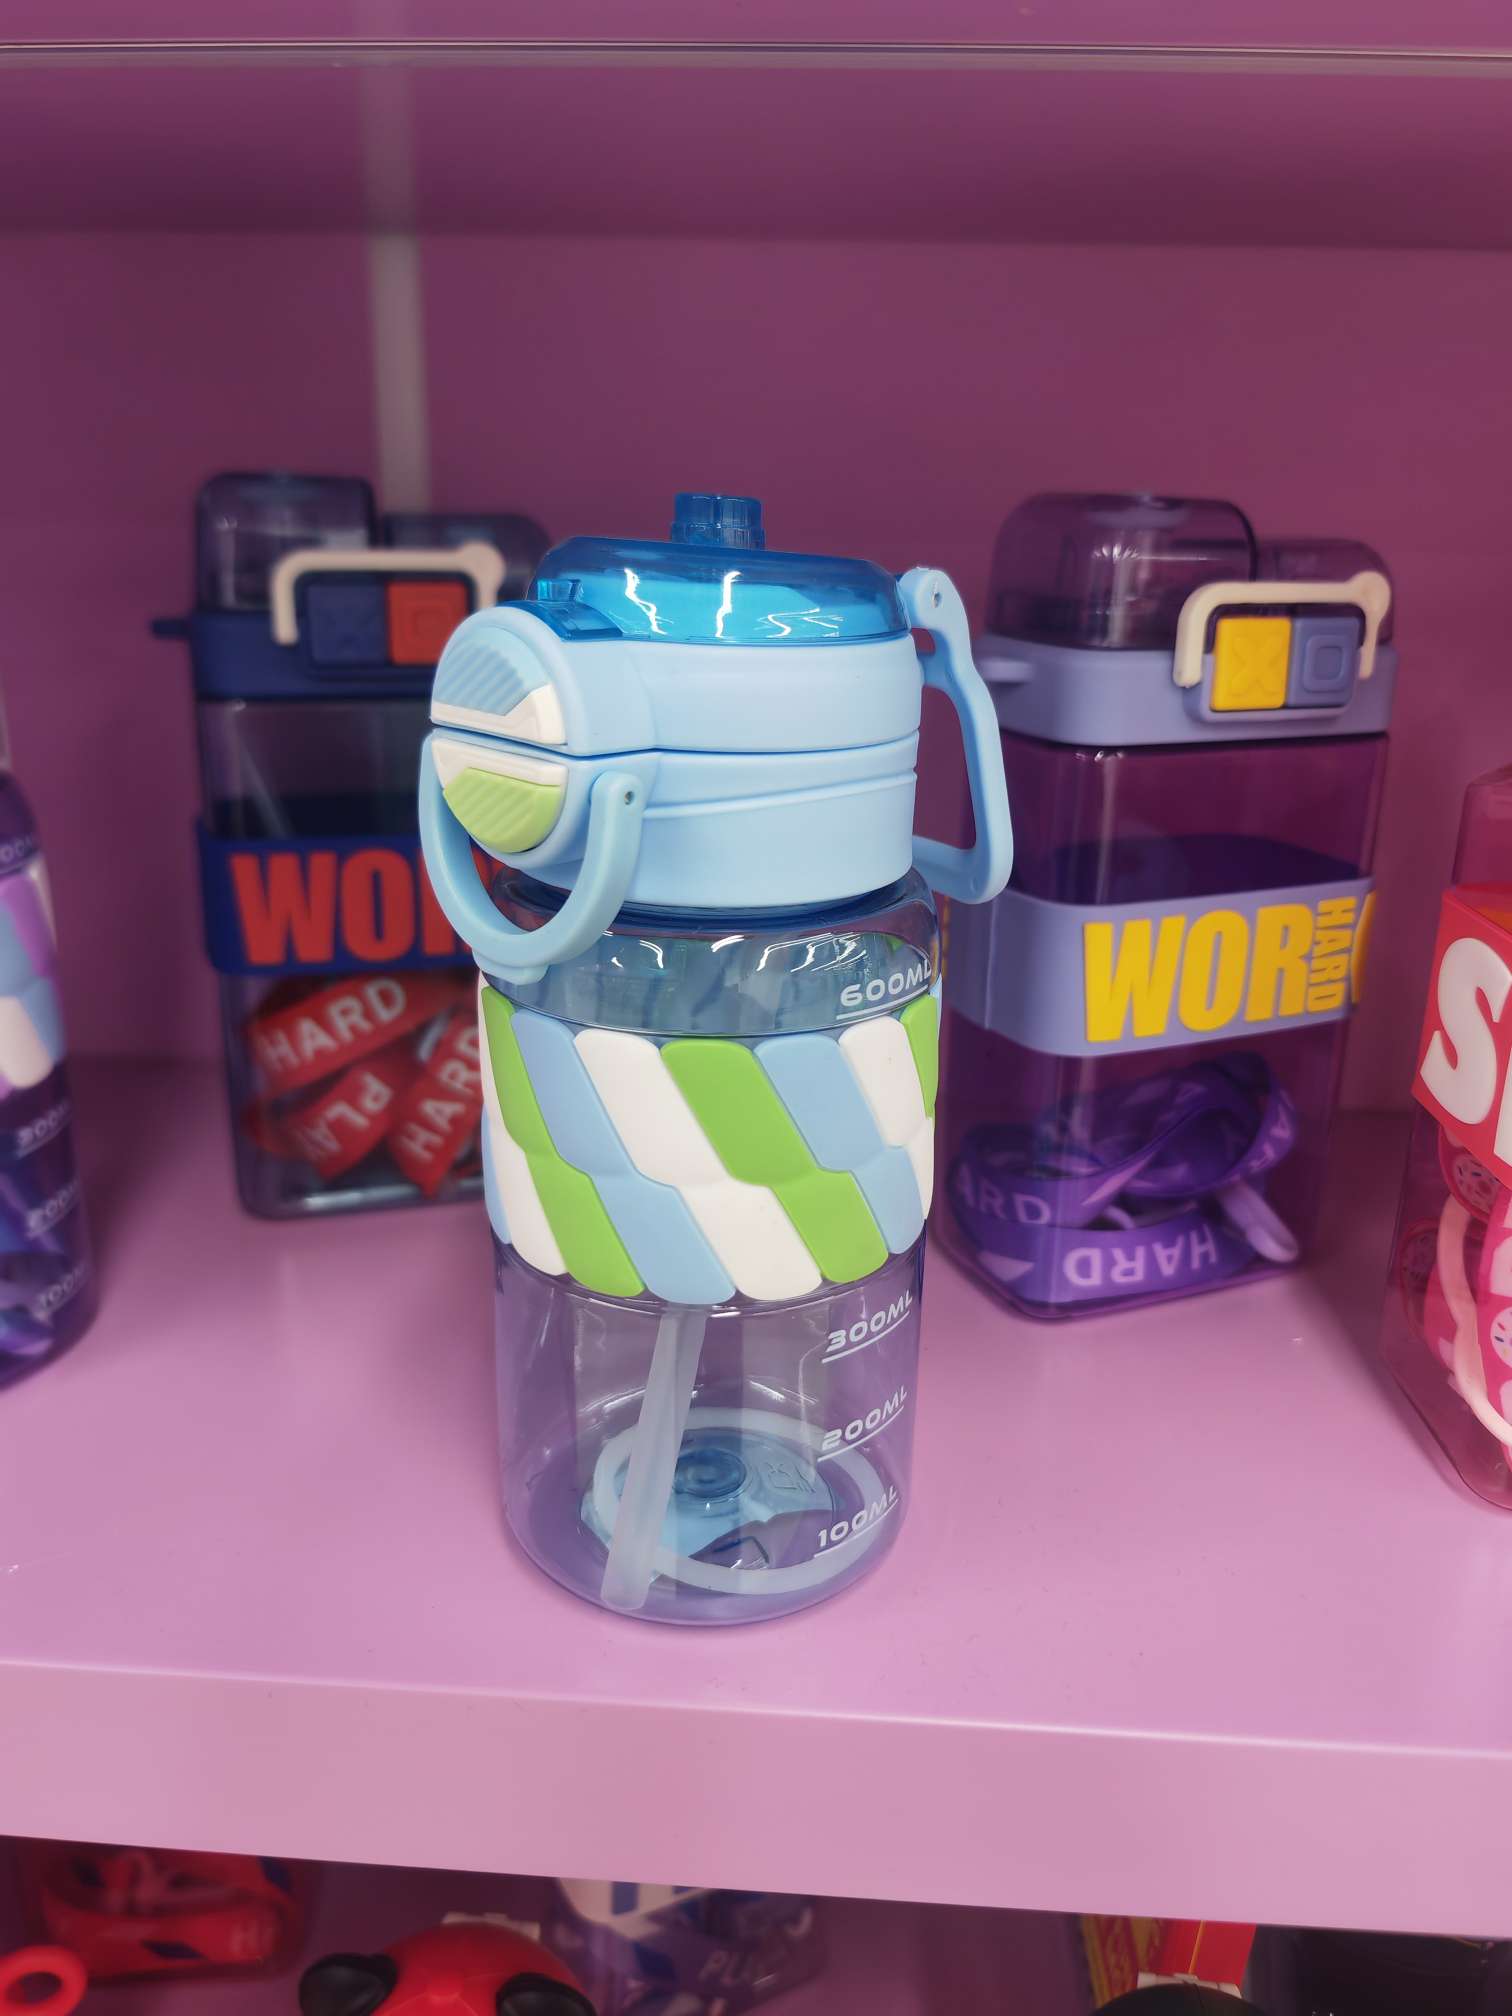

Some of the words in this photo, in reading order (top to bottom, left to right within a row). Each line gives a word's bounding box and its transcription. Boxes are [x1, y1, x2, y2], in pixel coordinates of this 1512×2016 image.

[840, 958, 932, 1007] 600ML
[1083, 904, 1315, 1043] WOR
[1305, 896, 1357, 1014] HARD
[261, 978, 407, 1071] HARD
[1419, 936, 1512, 1168] S
[953, 1160, 1051, 1226] ARD
[1062, 1221, 1219, 1288] HARD
[826, 1289, 913, 1353] 300ML
[821, 1385, 907, 1451] 200ML
[817, 1485, 898, 1548] 100ML
